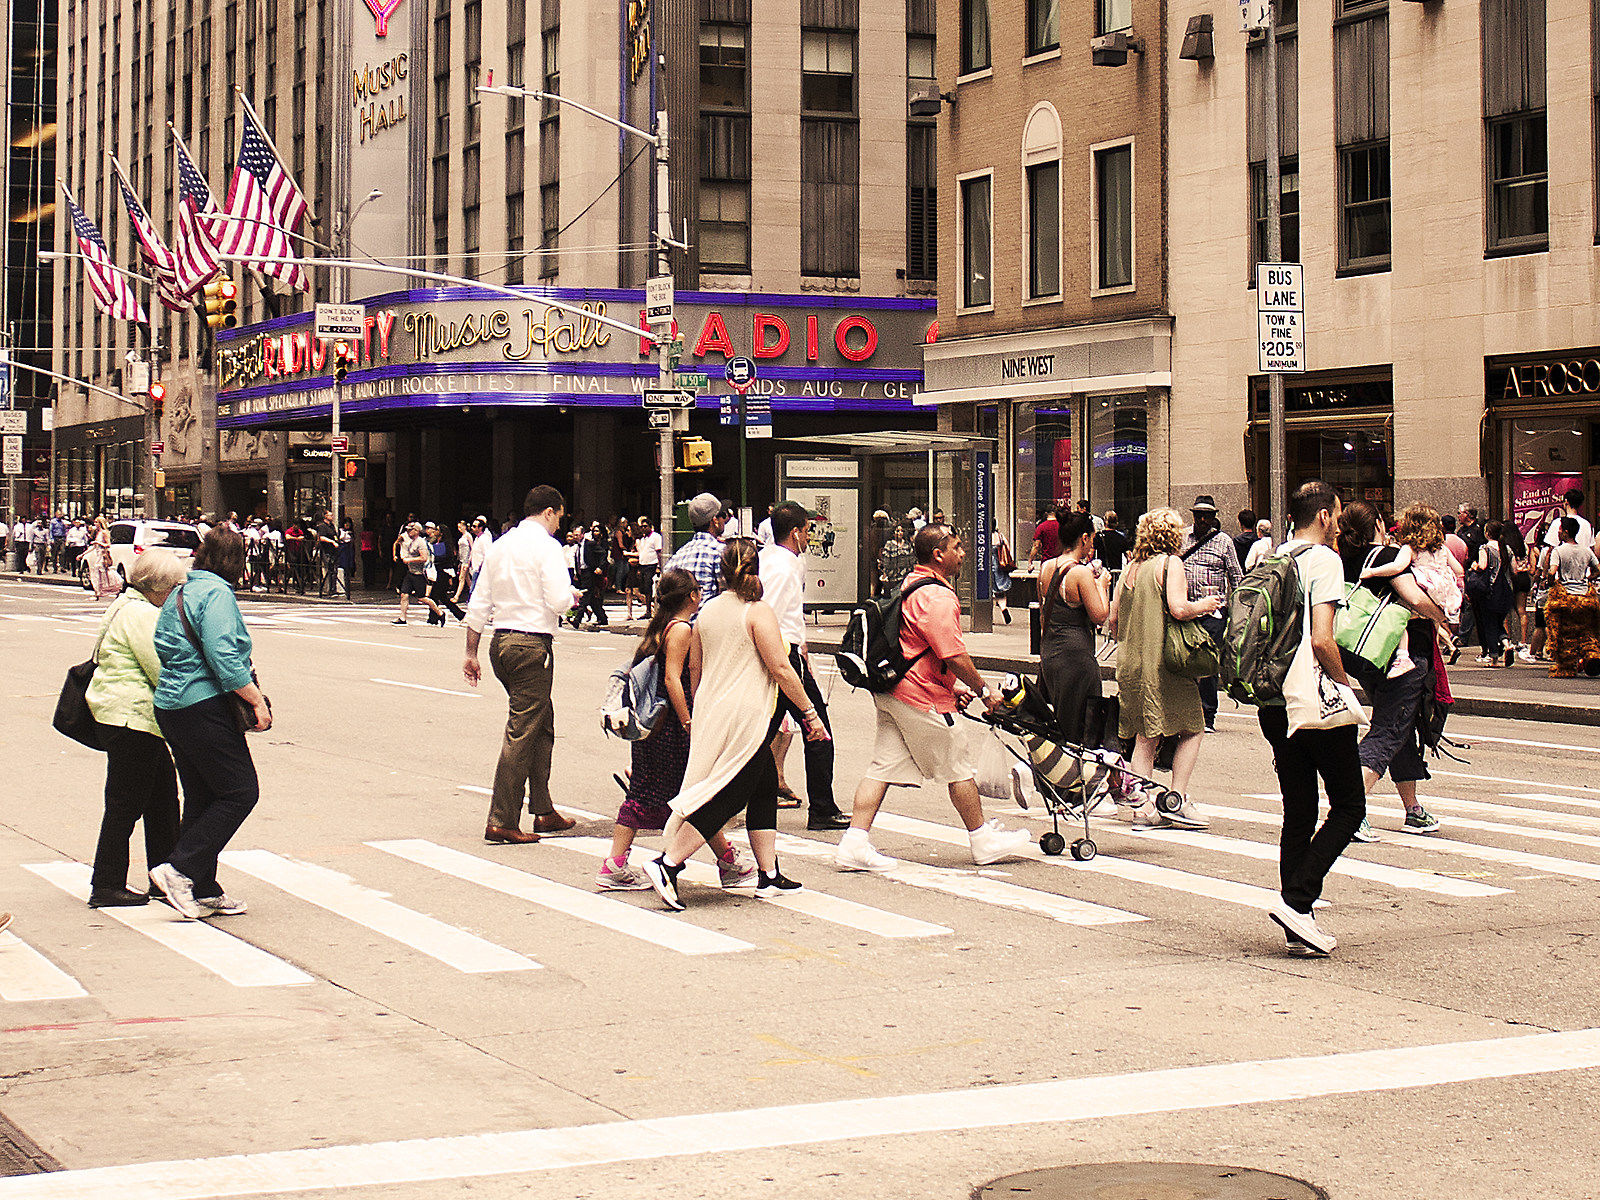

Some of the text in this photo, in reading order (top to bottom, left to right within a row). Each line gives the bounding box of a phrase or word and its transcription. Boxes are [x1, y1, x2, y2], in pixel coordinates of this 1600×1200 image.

[353, 53, 408, 107] MUSIC
[360, 94, 407, 145] HALL
[1268, 270, 1292, 286] BUS
[1264, 291, 1297, 306] LANE
[1265, 315, 1297, 326] TOW &
[404, 310, 510, 361] Music
[503, 301, 612, 361] Hall
[1271, 328, 1292, 339] FINE
[1001, 355, 1056, 379] NINE WEST
[1267, 360, 1298, 369] MINIMUM
[402, 375, 514, 395] ROCKETTES
[553, 375, 614, 393] FINAL
[802, 380, 843, 398] AUG
[859, 382, 869, 398] 7
[681, 376, 688, 387] W
[689, 376, 699, 387] 50
[647, 394, 690, 403] ONE WAY
[303, 449, 334, 459] Subway
[977, 470, 985, 501] Avenue
[1522, 487, 1552, 499] End of
[1514, 493, 1564, 508] Season Sa
[977, 511, 985, 532] West
[977, 546, 986, 572] Street
